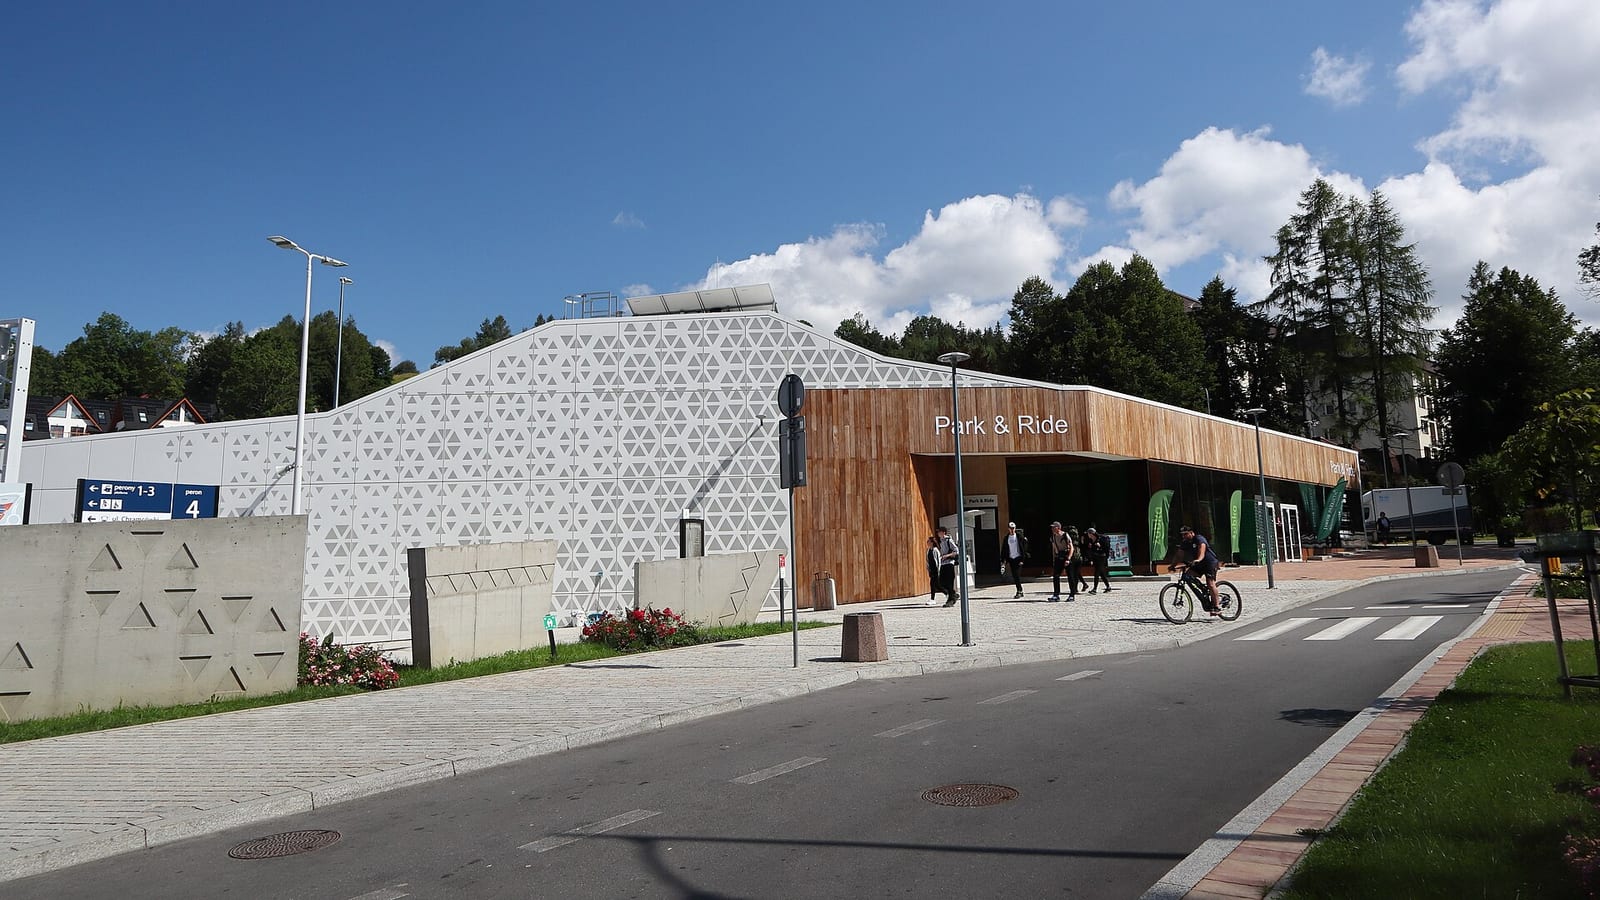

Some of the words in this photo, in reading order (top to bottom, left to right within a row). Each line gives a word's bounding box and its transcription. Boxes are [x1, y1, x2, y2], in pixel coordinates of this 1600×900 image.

[935, 415, 987, 435] Park
[993, 415, 1010, 434] &
[1018, 414, 1069, 434] Ride
[113, 485, 136, 493] perony
[137, 485, 155, 497] 1-3
[185, 499, 200, 519] 4
